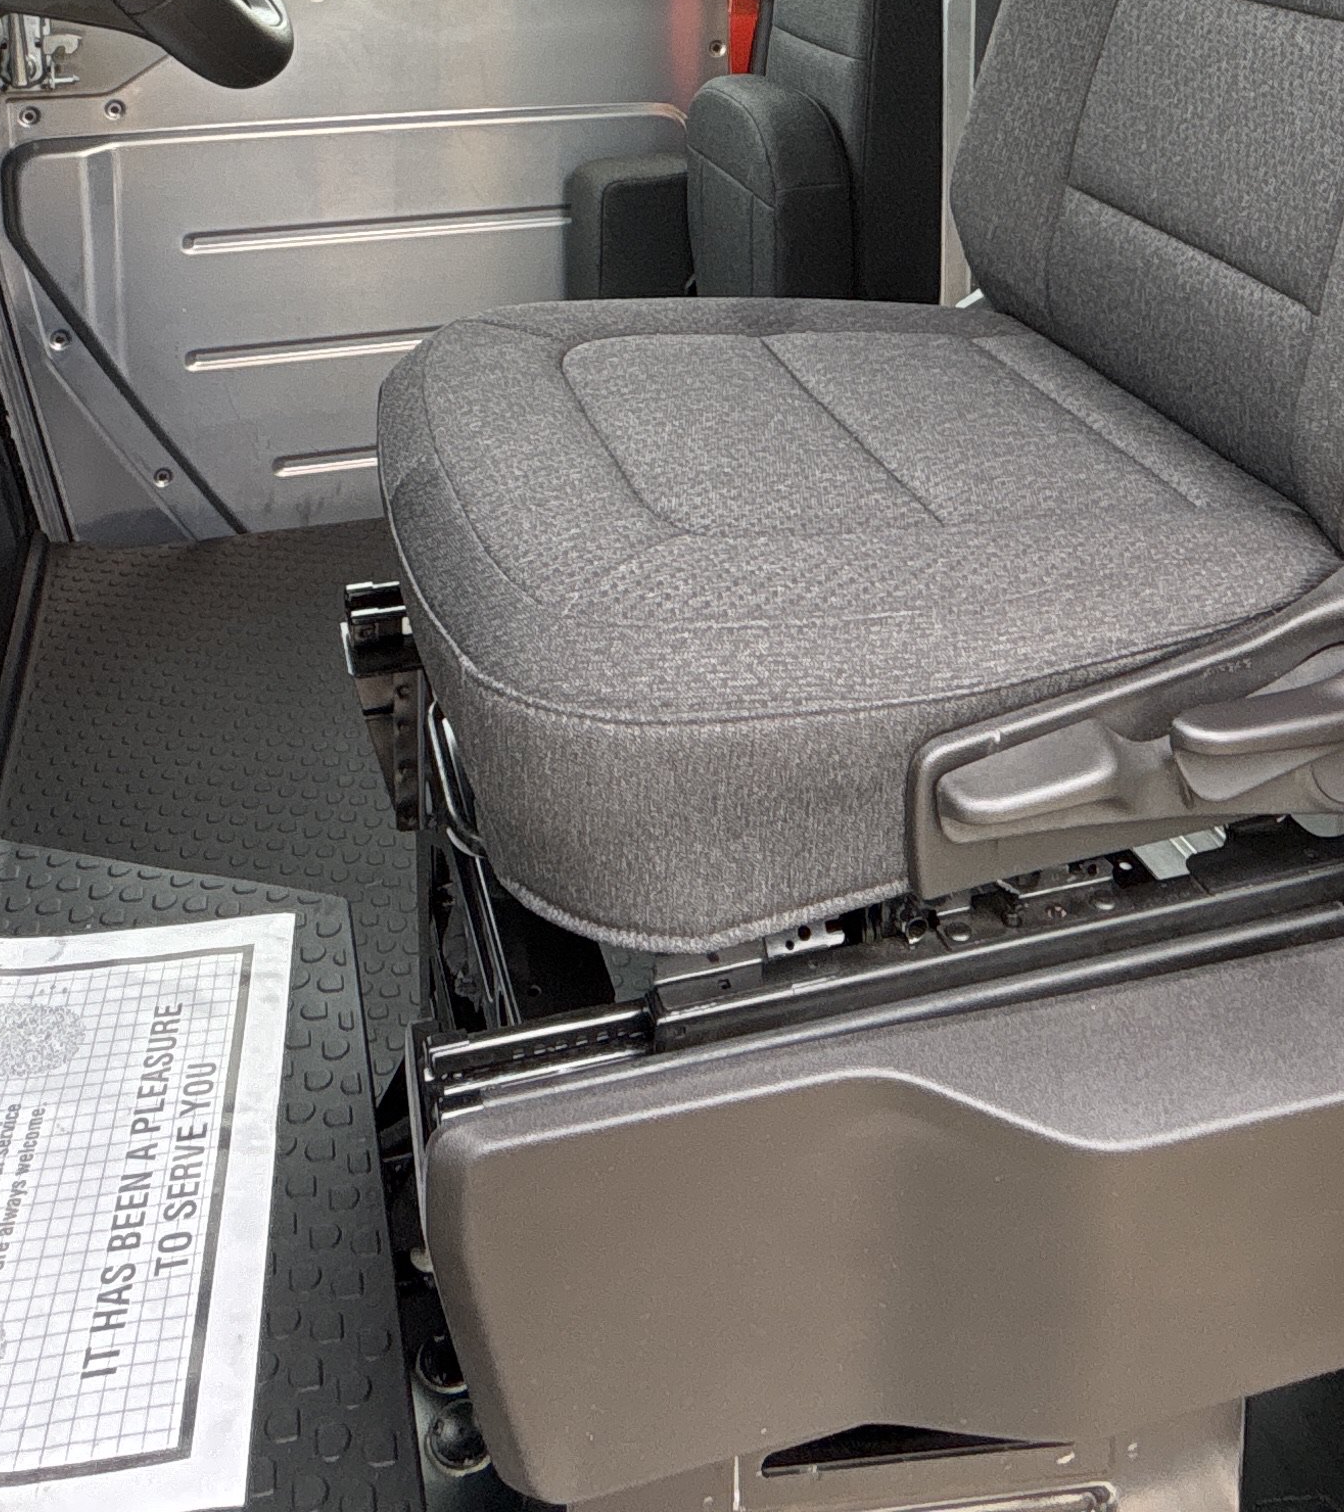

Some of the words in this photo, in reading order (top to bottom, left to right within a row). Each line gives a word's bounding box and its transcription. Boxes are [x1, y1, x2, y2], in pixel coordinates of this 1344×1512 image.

[130, 1002, 184, 1136] PLEASURE
[179, 1062, 217, 1117] YOU
[15, 1101, 48, 1177] welcome.
[125, 1142, 159, 1161] A
[163, 1122, 208, 1221] SERVE
[106, 1170, 154, 1253] BEEN
[154, 1231, 193, 1277] TO
[89, 1263, 136, 1333] HAS
[80, 1346, 121, 1380] IT
